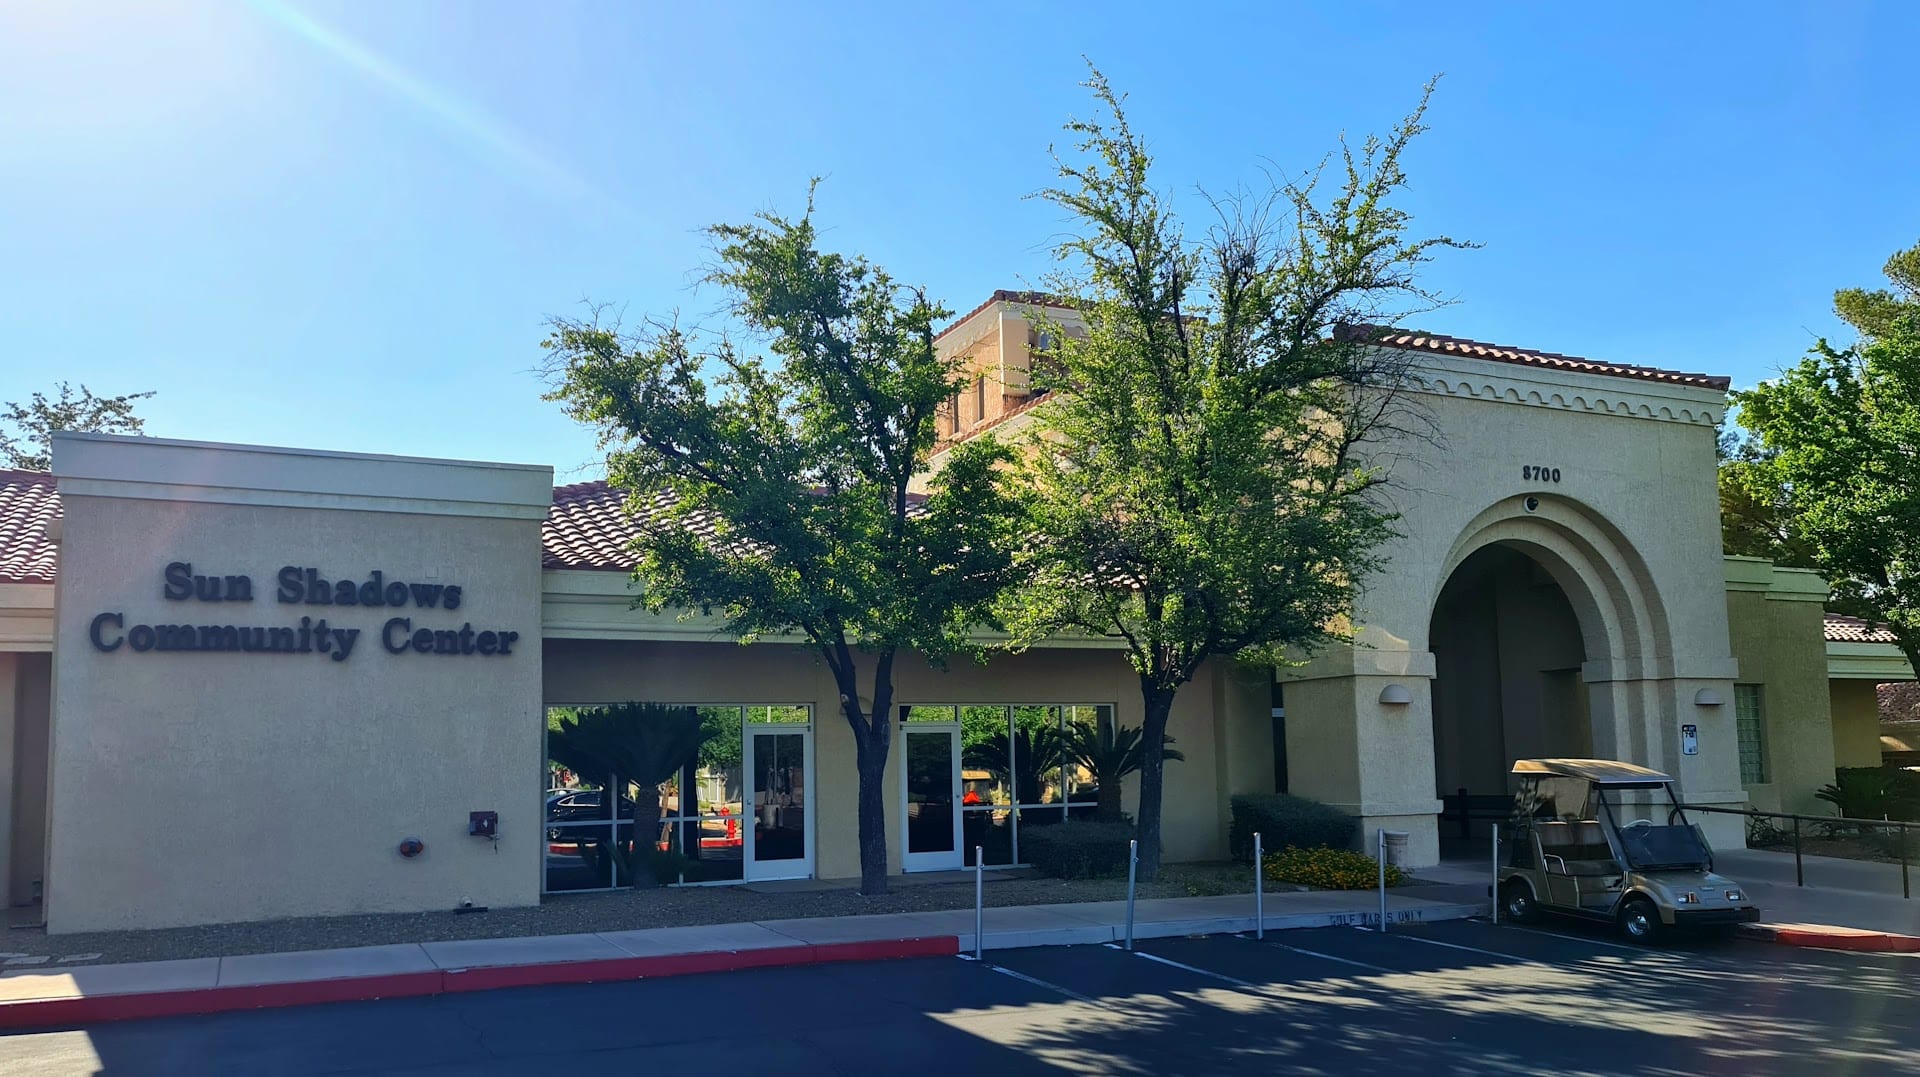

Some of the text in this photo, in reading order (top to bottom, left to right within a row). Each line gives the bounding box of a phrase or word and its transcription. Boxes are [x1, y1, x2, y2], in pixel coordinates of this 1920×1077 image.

[1522, 465, 1561, 483] 8700
[164, 562, 463, 610] Sun Shadows
[89, 612, 519, 662] Community Center
[1362, 911, 1393, 924] CARS
[1399, 910, 1423, 921] ONLY
